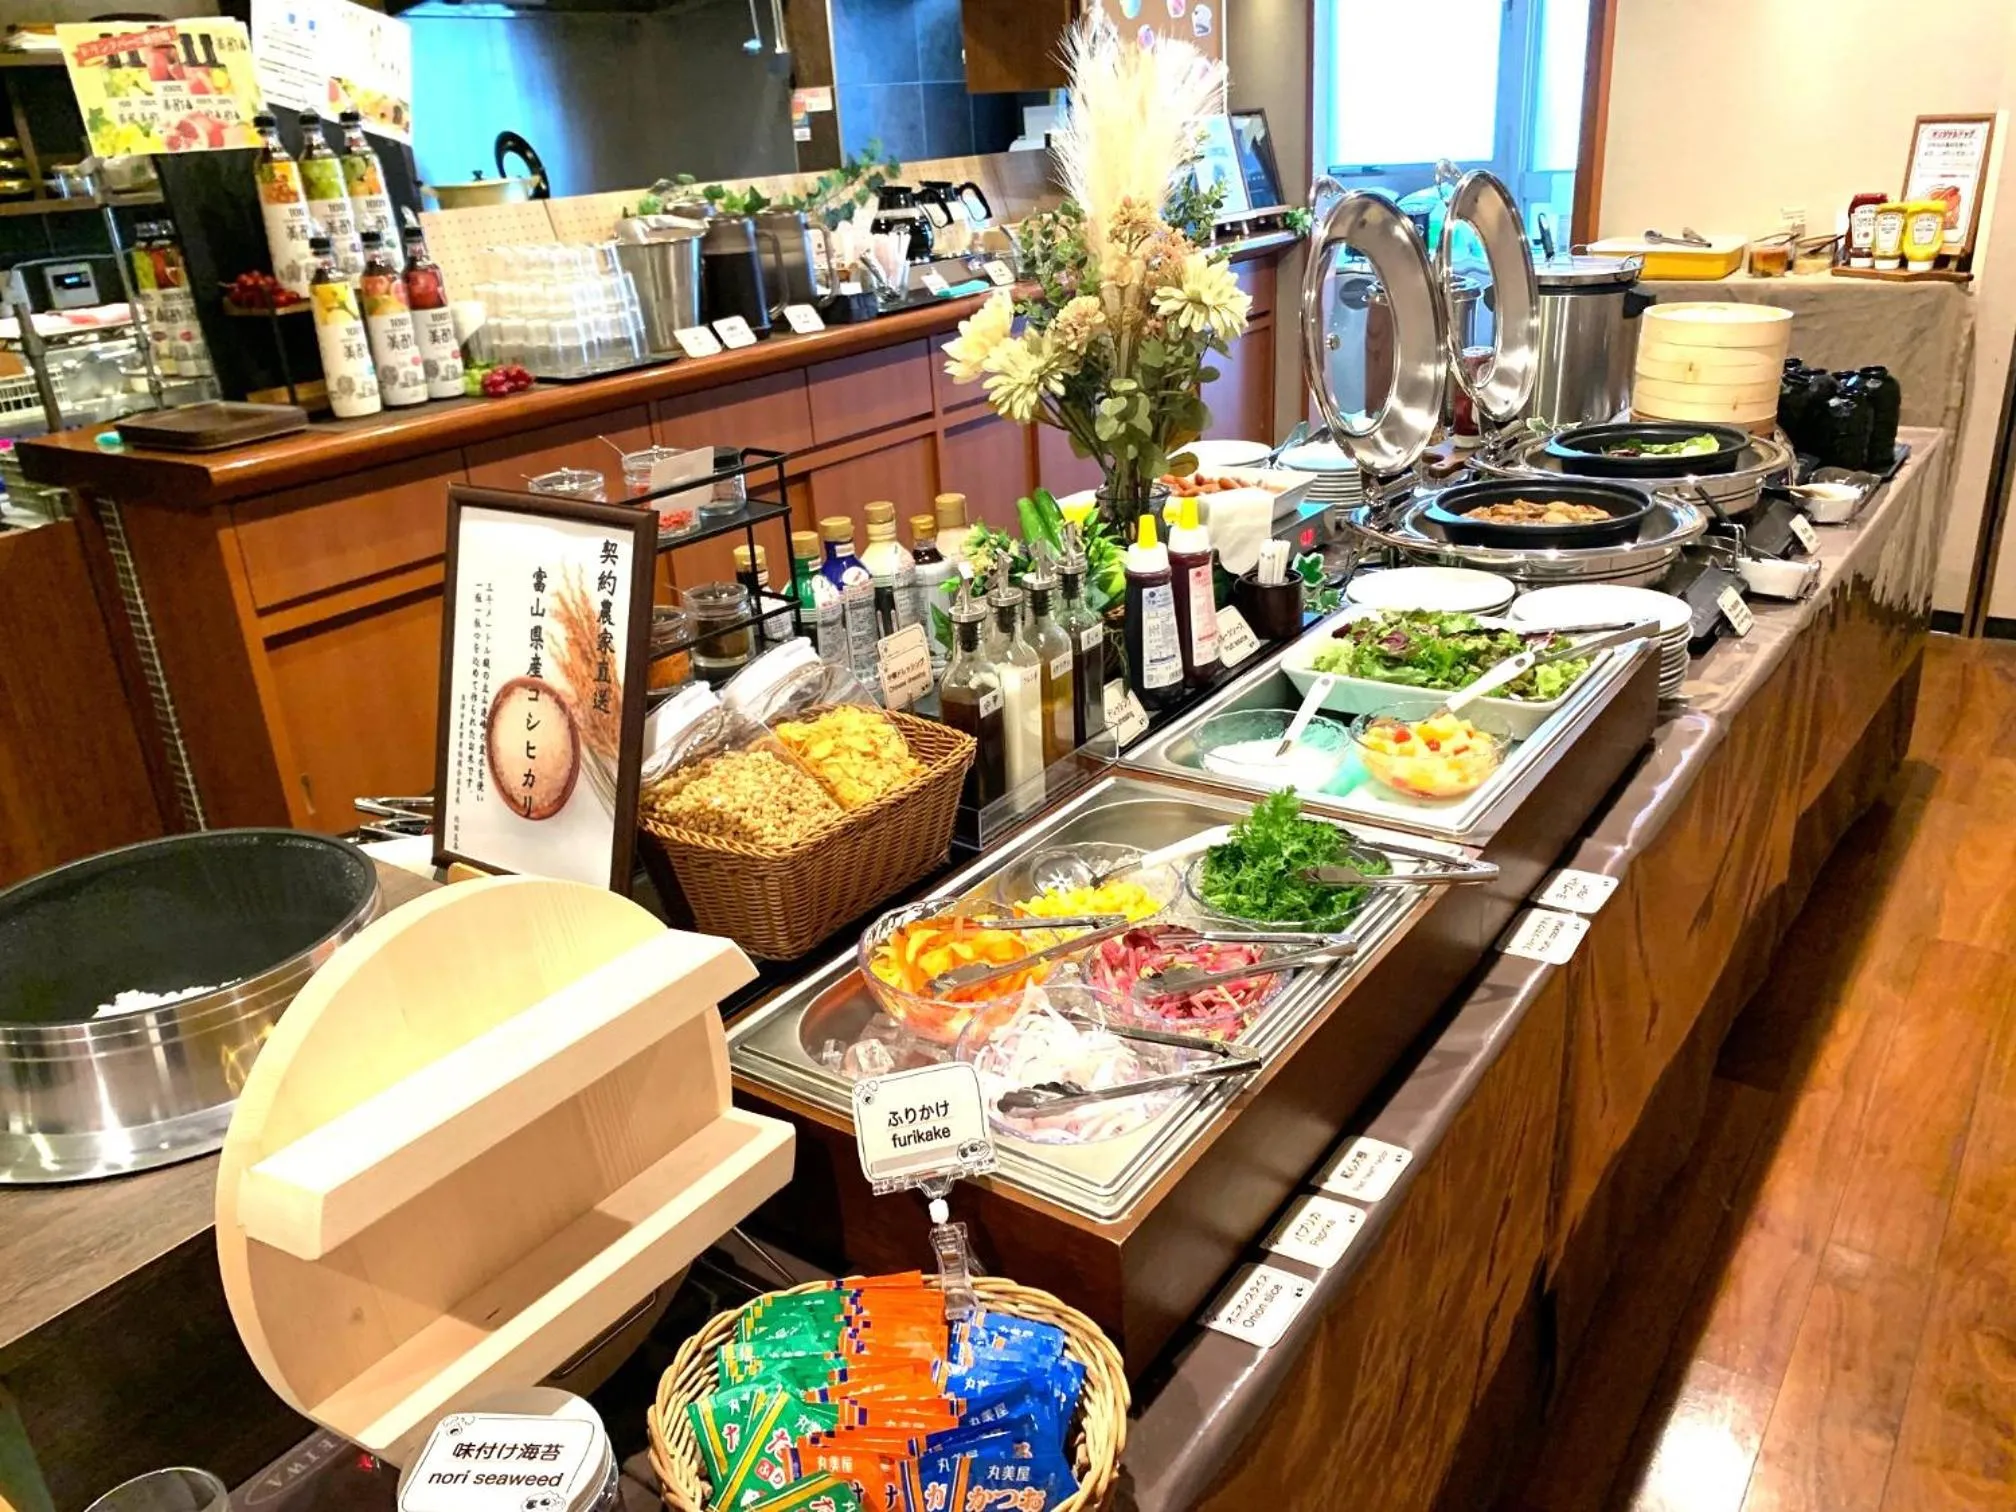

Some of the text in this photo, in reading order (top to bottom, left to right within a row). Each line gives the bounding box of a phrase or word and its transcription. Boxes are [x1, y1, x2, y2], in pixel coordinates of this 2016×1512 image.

[592, 538, 620, 716] 契約農家直送
[521, 566, 548, 819] 富山県産コシヒカリ
[888, 1100, 950, 1127] ふりかけ
[891, 1125, 952, 1149] furikake
[1225, 1273, 1270, 1326] オニオンスライス
[1242, 1283, 1284, 1329] Onion slice
[265, 1438, 337, 1488] EIWA
[451, 1441, 565, 1462] 味付け海苔
[427, 1469, 564, 1488] nori seaweed
[987, 1464, 1032, 1482] 丸美屋
